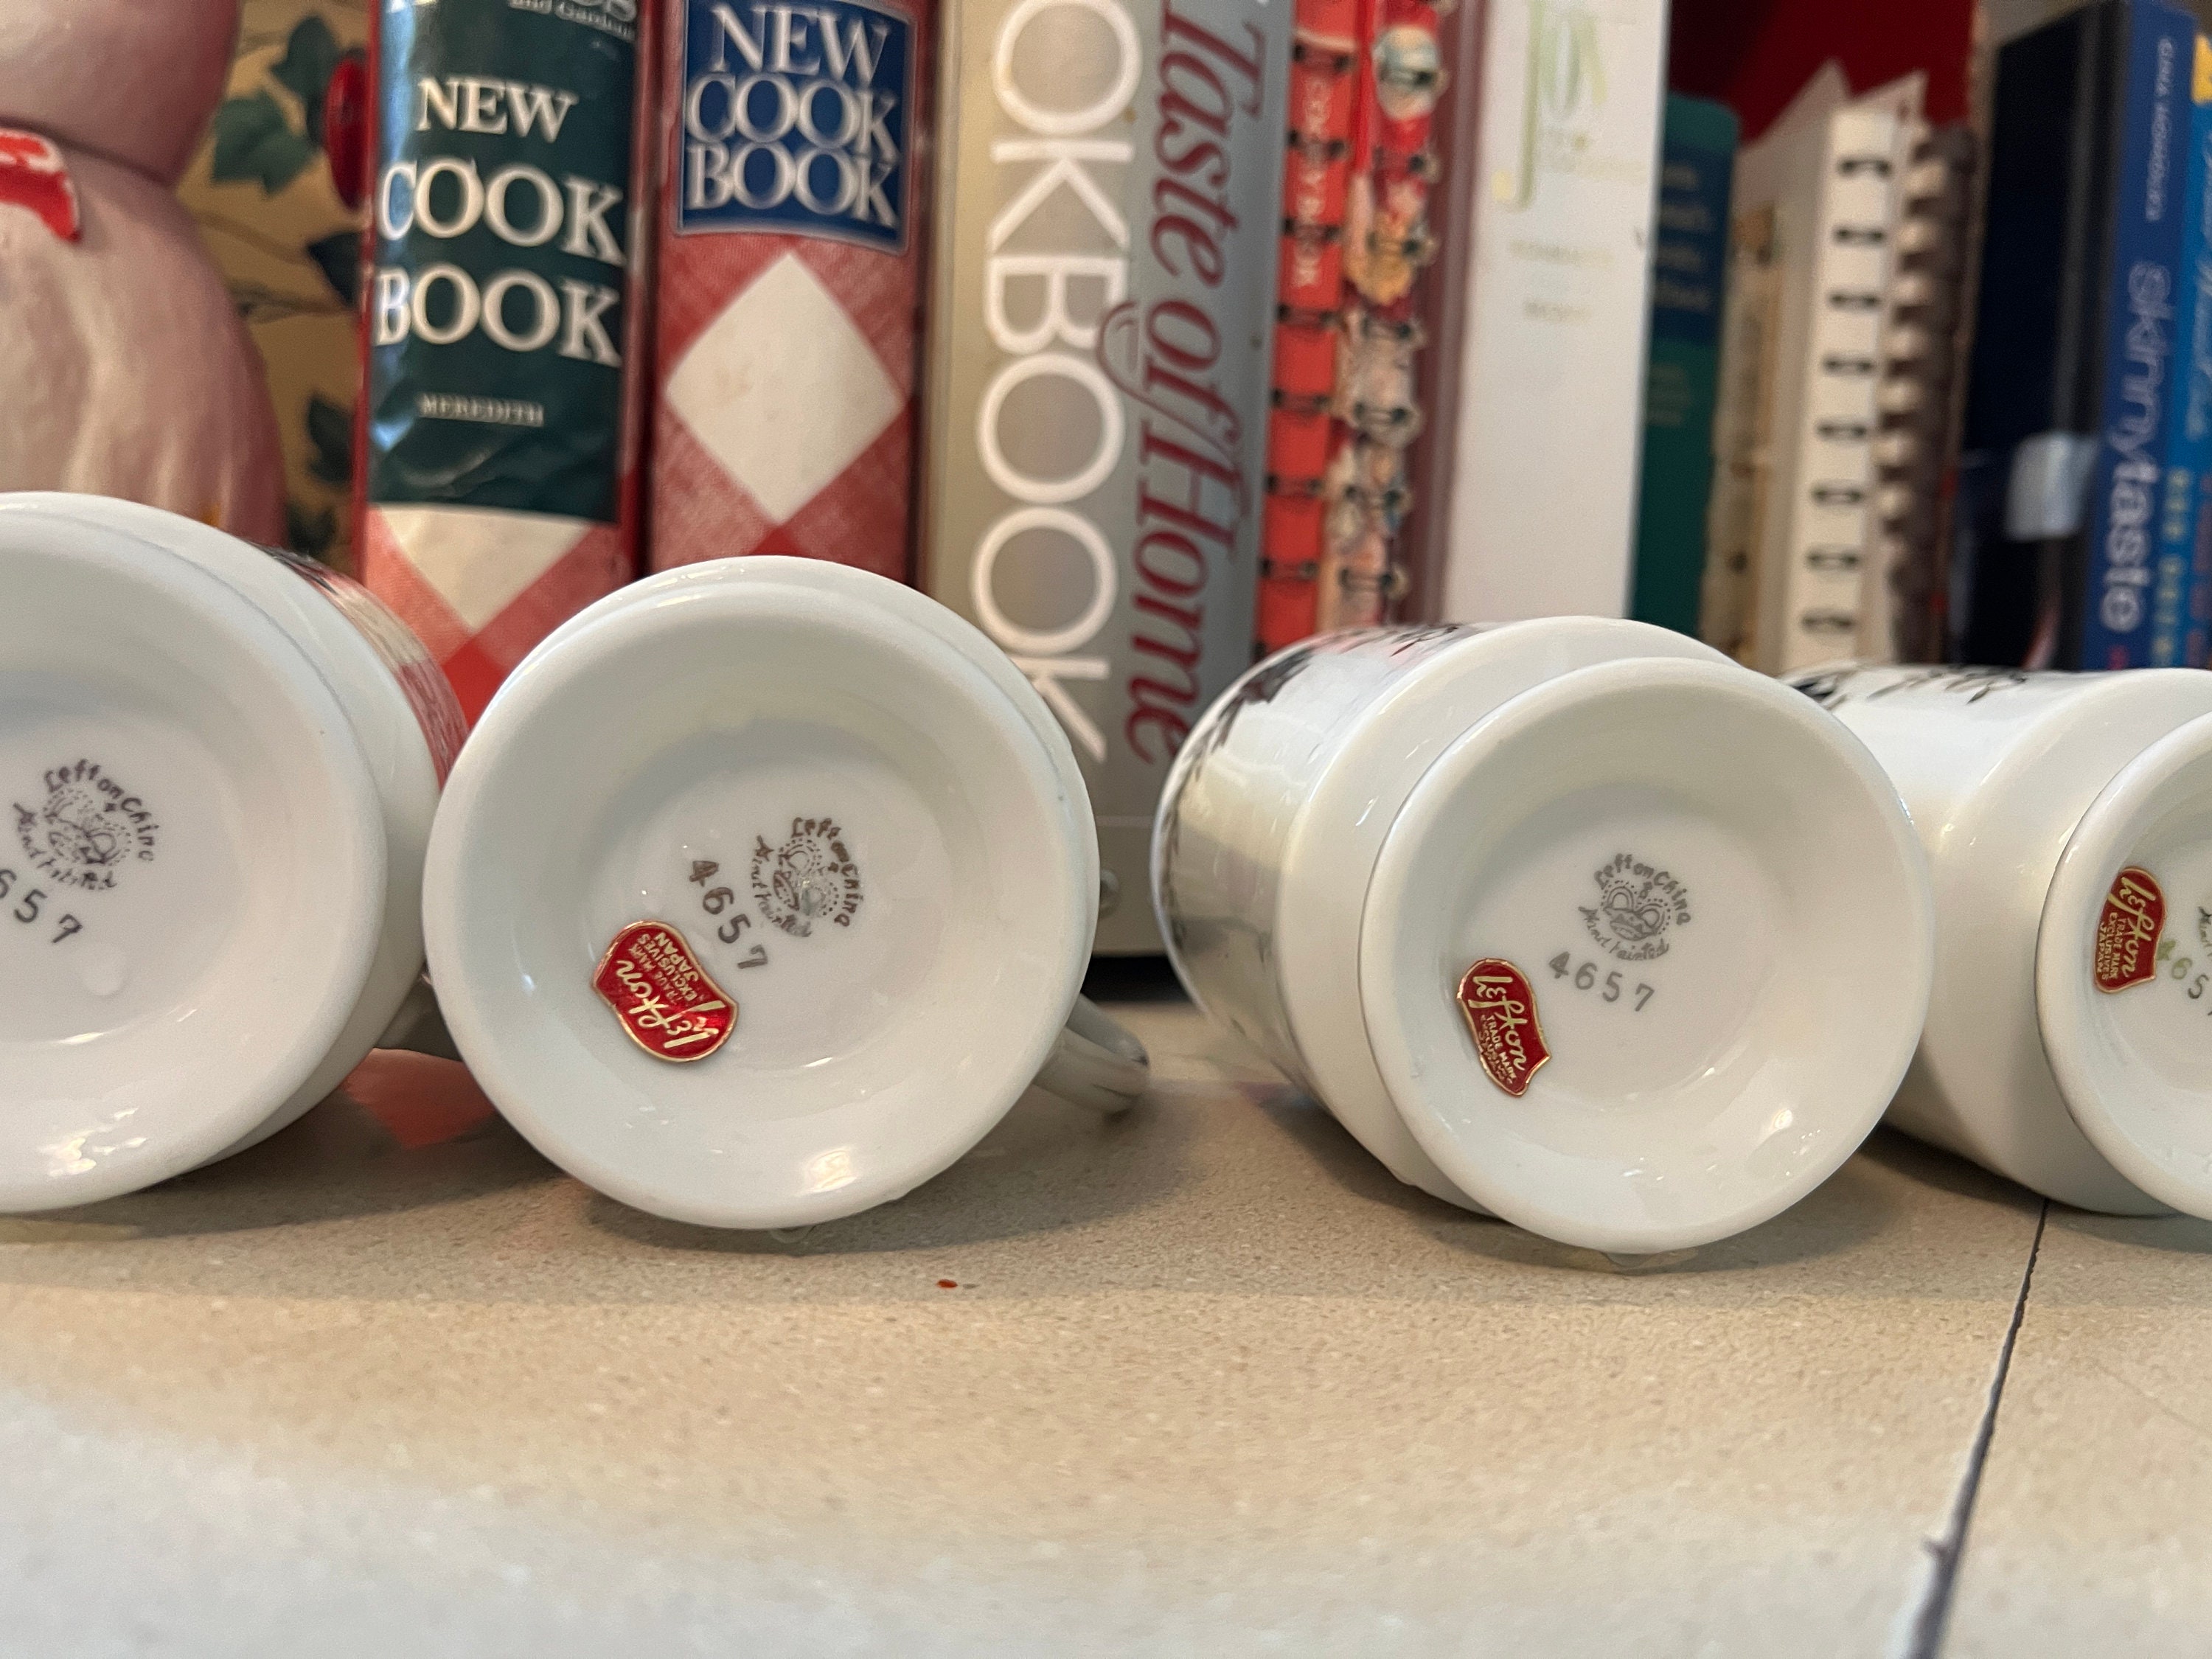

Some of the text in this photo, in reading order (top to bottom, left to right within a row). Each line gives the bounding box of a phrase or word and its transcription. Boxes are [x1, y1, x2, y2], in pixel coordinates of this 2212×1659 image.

[709, 4, 891, 84] NEW
[417, 77, 579, 143] NEW
[686, 74, 899, 164] COOK
[1149, 0, 1270, 290] Taste
[380, 156, 626, 266] COOK
[684, 140, 897, 229] BOOK
[373, 262, 622, 366] BOOK
[415, 393, 544, 428] MEREDITH
[1110, 383, 1251, 765] Home
[654, 931, 700, 983] JAPAN
[689, 860, 769, 970] 4657
[2107, 876, 2157, 978] Lefton
[616, 959, 726, 1049] Lefton
[637, 933, 698, 1002] EXCLUSIVES
[1548, 950, 1655, 1012] 4657
[1467, 975, 1528, 1071] Lefton
[1485, 1015, 1503, 1051] TRADE
